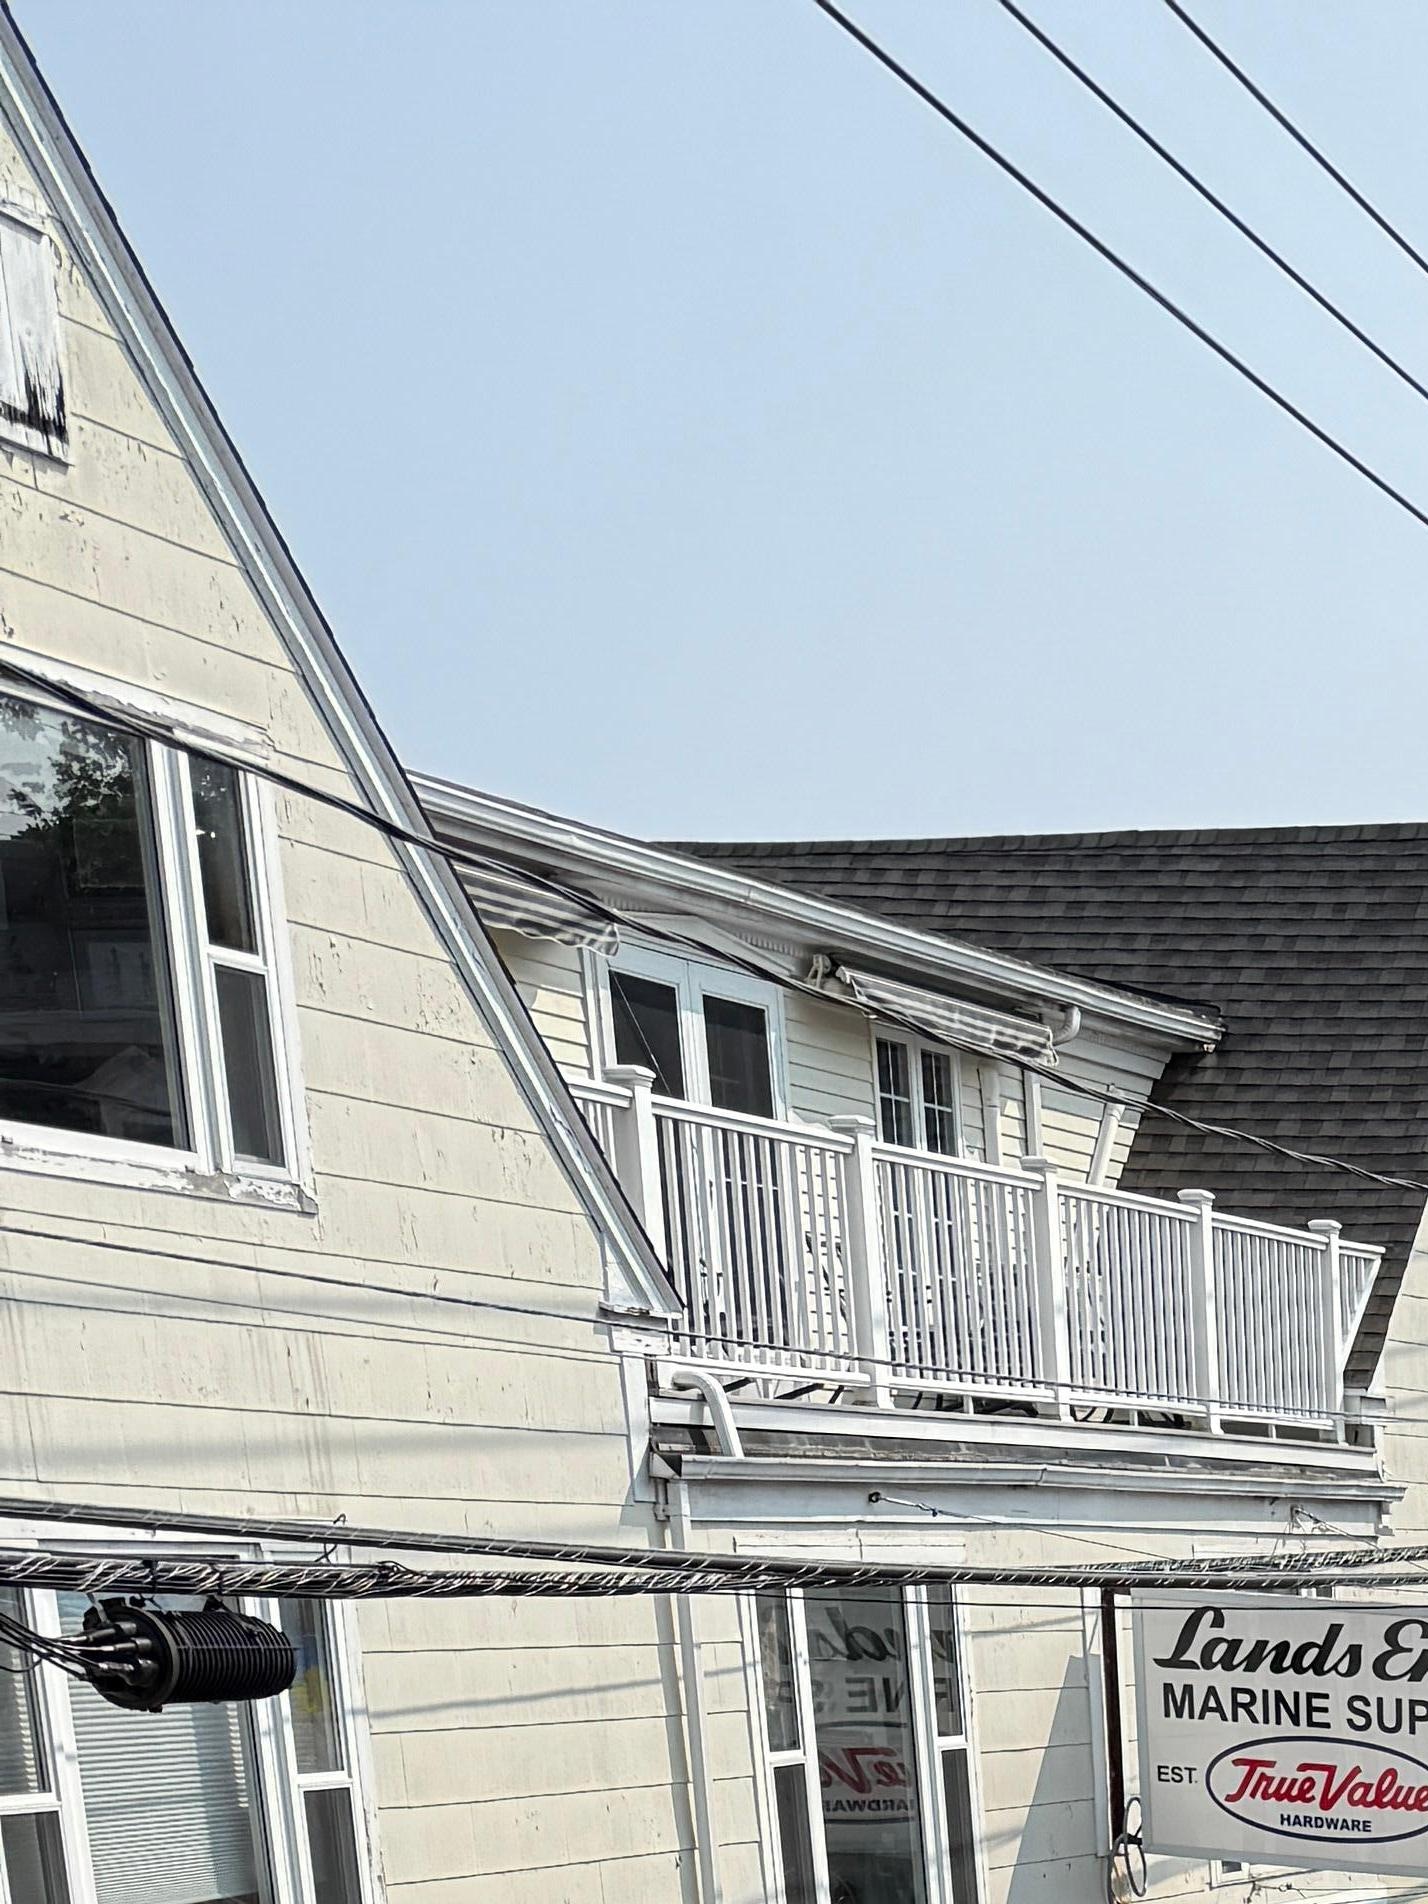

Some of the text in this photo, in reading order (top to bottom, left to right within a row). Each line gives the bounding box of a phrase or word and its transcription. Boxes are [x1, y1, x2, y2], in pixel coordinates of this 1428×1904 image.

[1152, 1606, 1363, 1678] Lands
[1163, 1682, 1332, 1729] MARINE
[1157, 1765, 1199, 1785] EST.
[1279, 1813, 1373, 1834] HARDWARE
